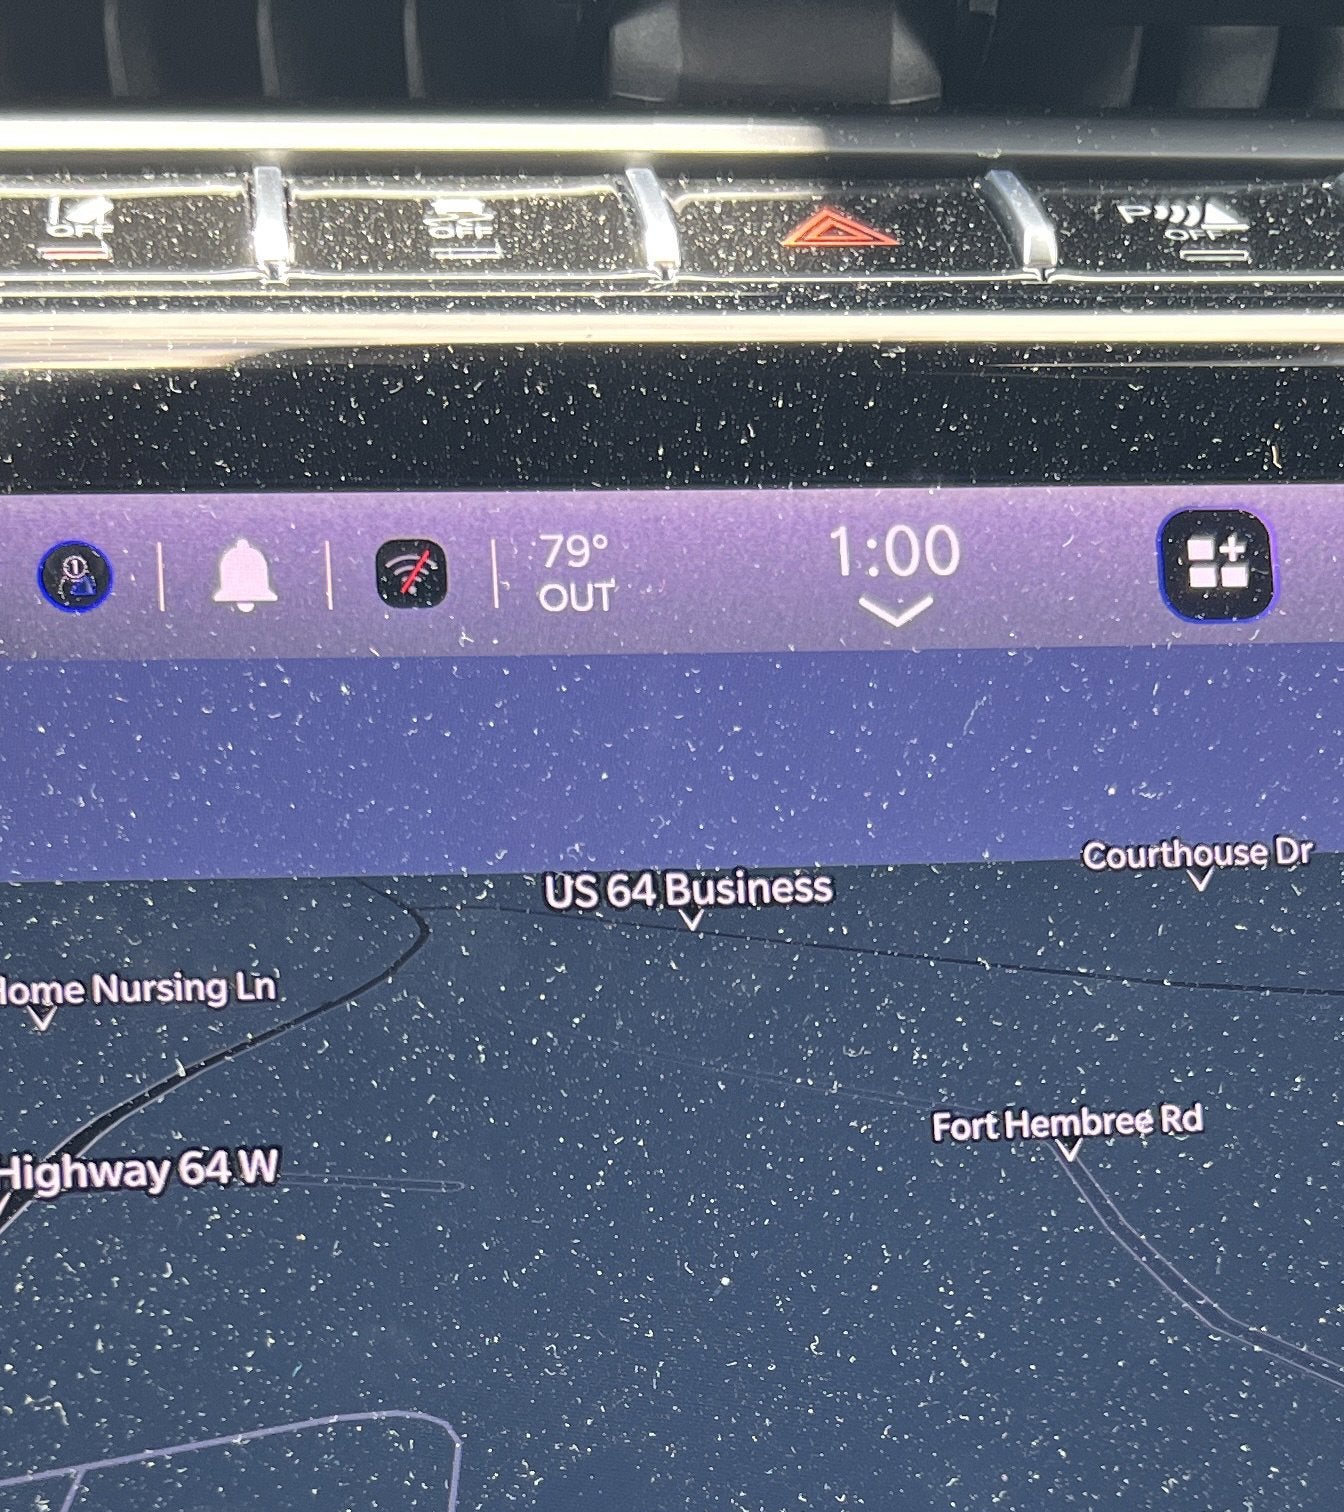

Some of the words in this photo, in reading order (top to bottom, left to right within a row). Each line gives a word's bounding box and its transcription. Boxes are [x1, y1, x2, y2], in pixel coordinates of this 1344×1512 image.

[46, 223, 115, 238] OFF
[428, 225, 494, 239] OFF
[1116, 204, 1153, 224] P
[1164, 228, 1224, 241] OFF
[537, 533, 609, 569] 79°
[830, 523, 961, 579] 1:00
[538, 581, 615, 613] OUT
[1083, 839, 1267, 872] Courthouse
[1276, 836, 1313, 867] Dr
[546, 873, 598, 910] US
[606, 872, 655, 908] 64
[667, 870, 833, 906] Business
[93, 973, 227, 1009] Nursing
[235, 971, 275, 1001] Ln
[932, 1112, 999, 1143] Fort
[1005, 1108, 1153, 1139] Hembree
[1162, 1104, 1203, 1134] Rd
[178, 1152, 230, 1185] 64
[237, 1149, 279, 1183] W
